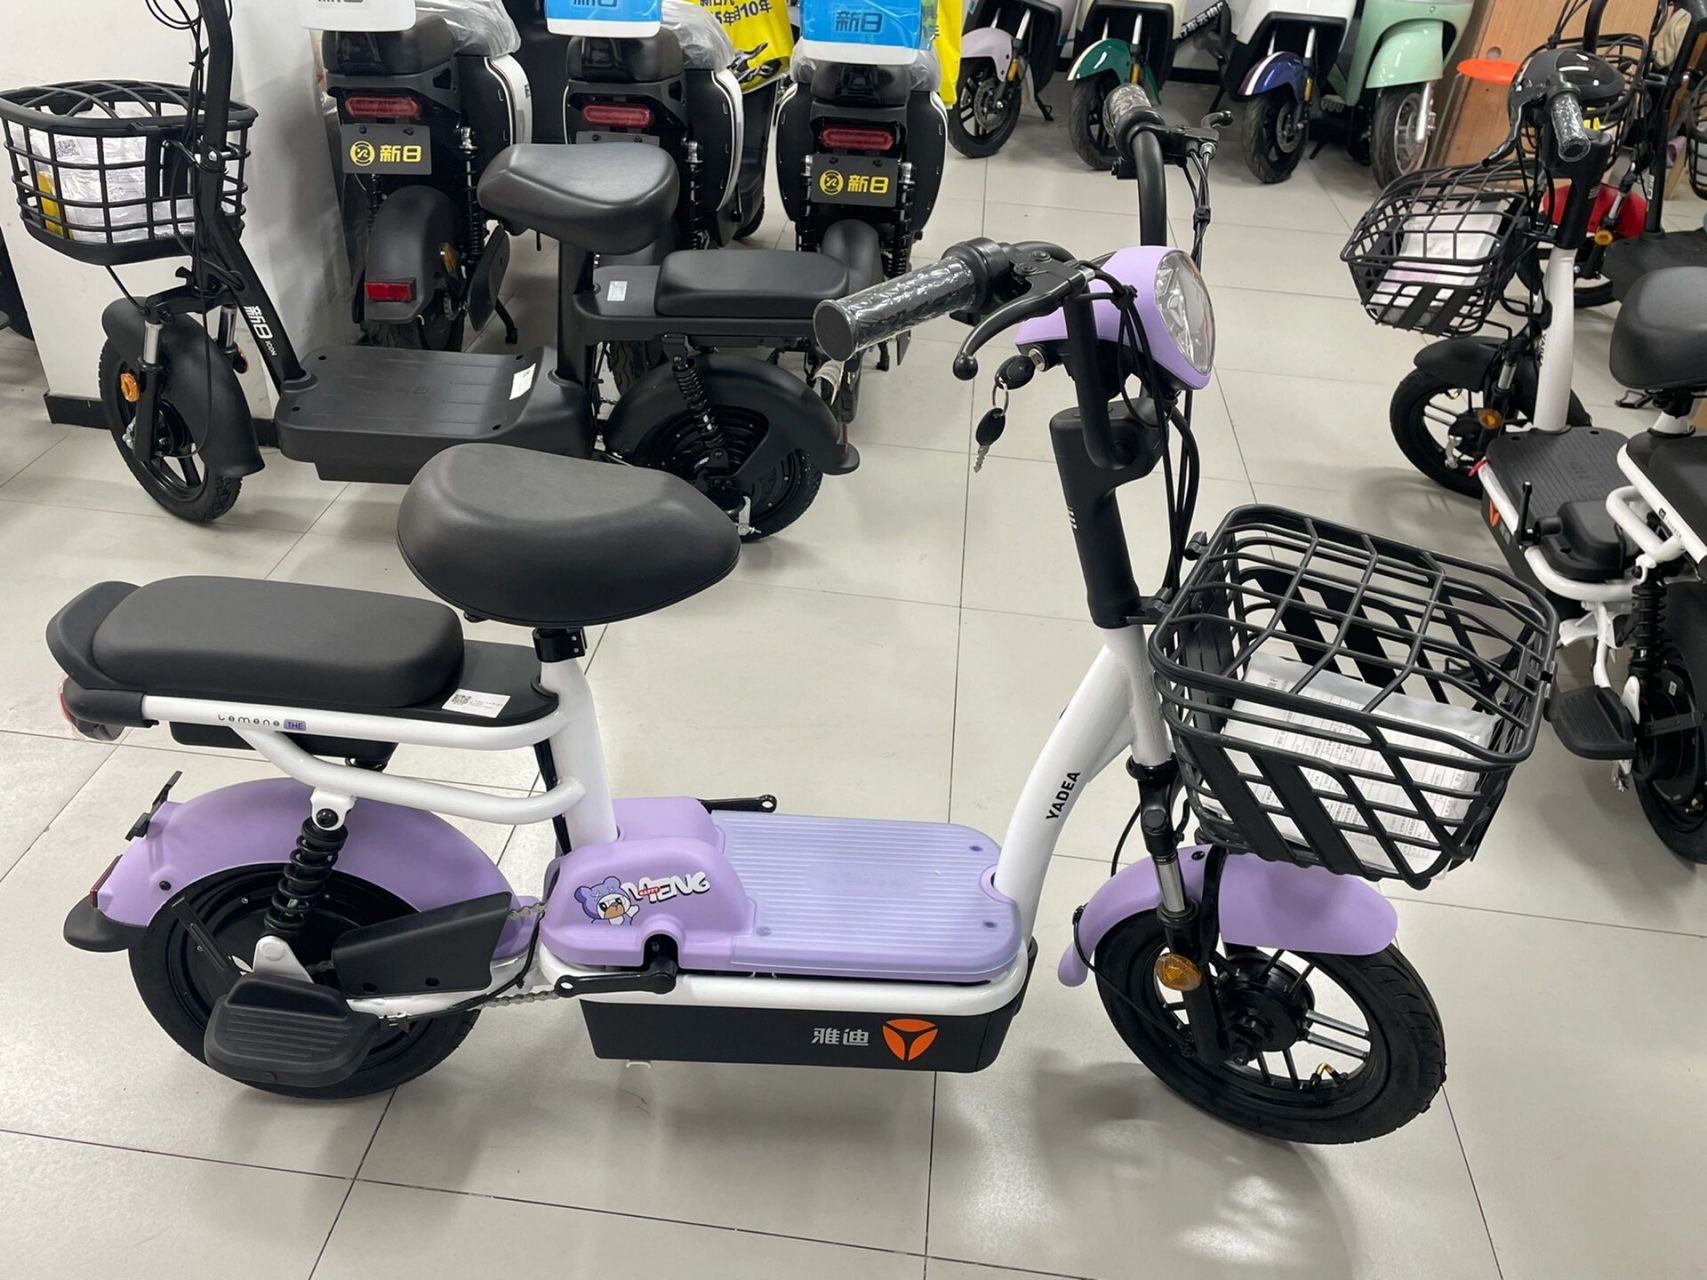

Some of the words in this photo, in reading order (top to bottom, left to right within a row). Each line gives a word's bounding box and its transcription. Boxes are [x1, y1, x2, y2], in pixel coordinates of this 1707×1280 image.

[835, 11, 883, 33] 新日
[379, 144, 422, 163] 新日
[847, 174, 889, 194] 新日
[243, 305, 273, 339] 新日
[1045, 771, 1081, 820] YADEA
[811, 1027, 870, 1046] 雅迪
